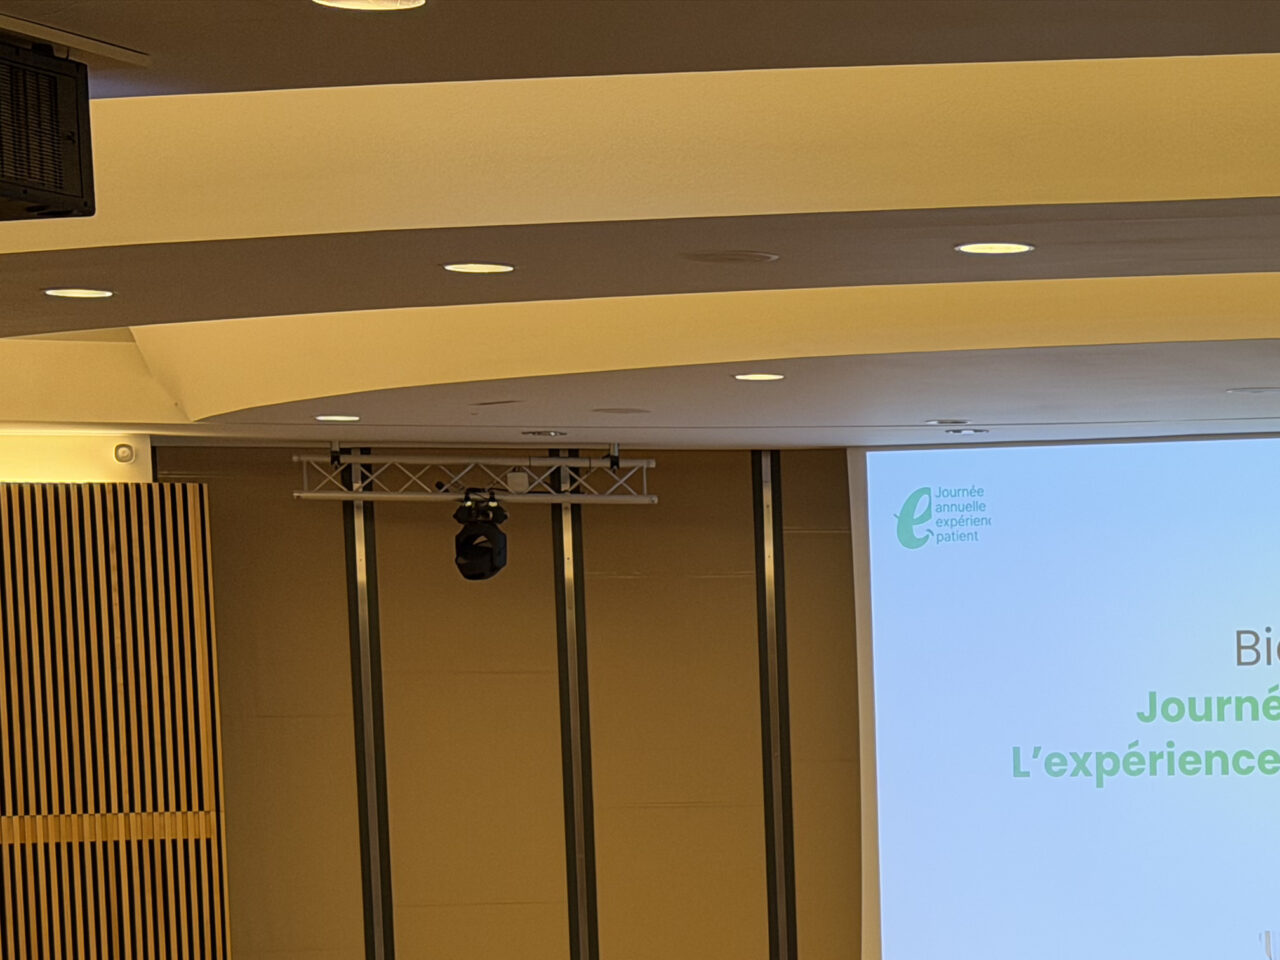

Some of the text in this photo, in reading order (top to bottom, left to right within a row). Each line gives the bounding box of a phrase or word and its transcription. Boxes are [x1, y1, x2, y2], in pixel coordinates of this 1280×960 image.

[935, 485, 985, 499] Journée
[935, 500, 987, 513] annuelle
[936, 531, 980, 544] patient
